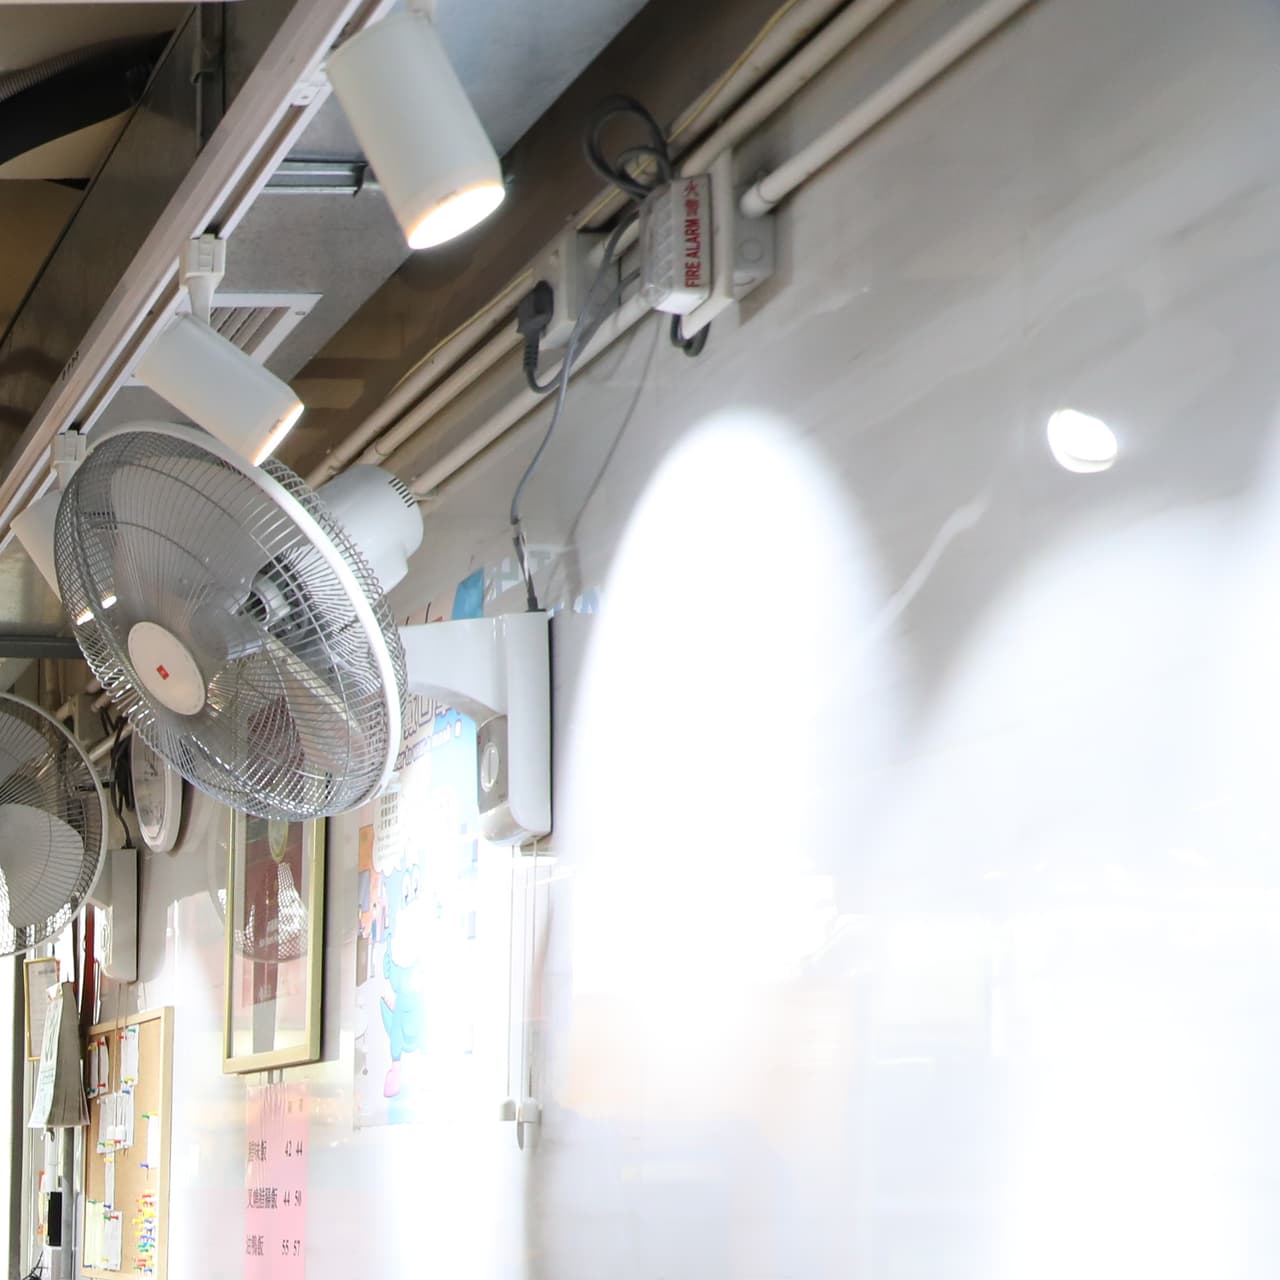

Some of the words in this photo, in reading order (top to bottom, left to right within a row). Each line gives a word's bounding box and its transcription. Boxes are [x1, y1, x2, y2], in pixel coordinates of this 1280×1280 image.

[685, 219, 701, 258] ALARM
[685, 262, 701, 288] FIRE
[285, 1140, 292, 1157] 42
[296, 1140, 303, 1156] 44
[284, 1191, 290, 1206] 44
[282, 1240, 289, 1255] 55
[293, 1240, 300, 1256] 57
